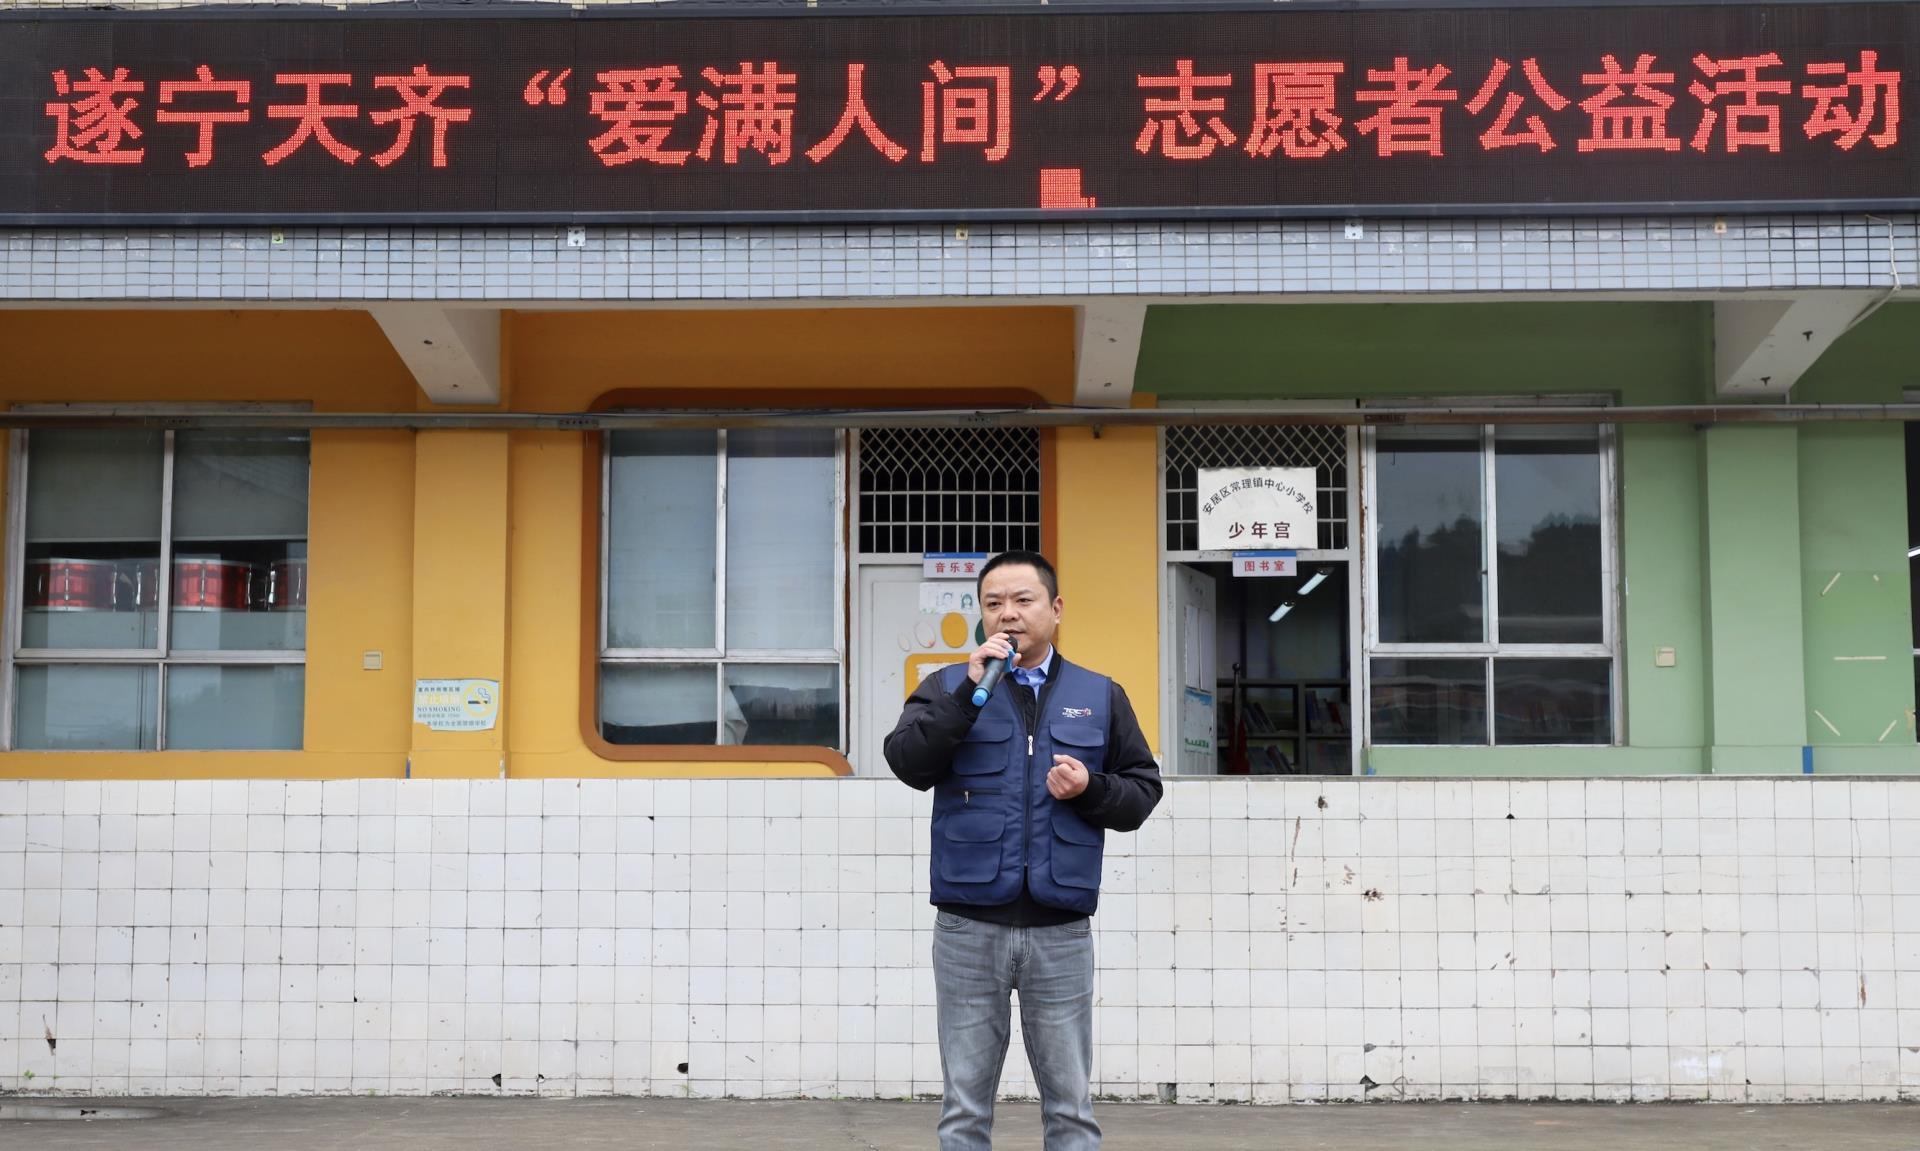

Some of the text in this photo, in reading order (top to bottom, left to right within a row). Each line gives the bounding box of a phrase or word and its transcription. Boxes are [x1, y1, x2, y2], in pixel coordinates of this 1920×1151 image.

[1202, 477, 1314, 515] 安居区常理镇中心小学校
[1228, 521, 1291, 540] 少年宫
[935, 561, 976, 574] 音乐室
[1243, 560, 1286, 573] 图书室
